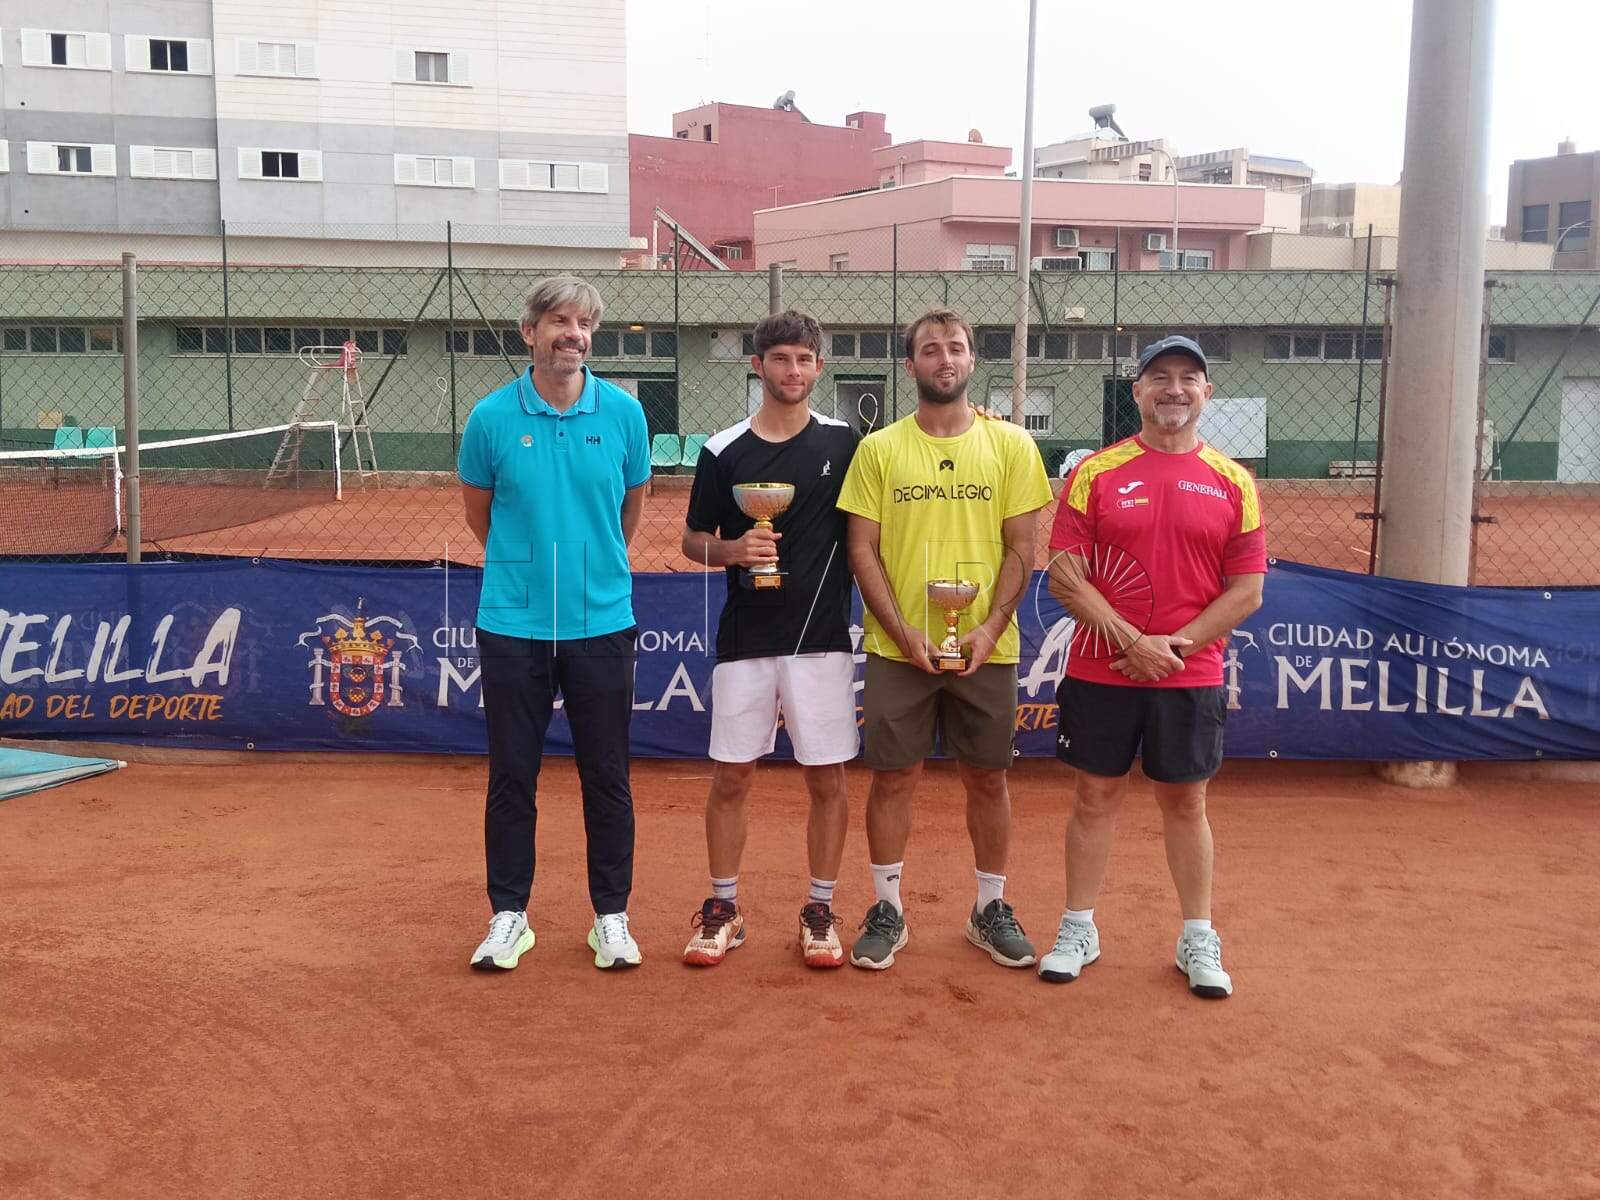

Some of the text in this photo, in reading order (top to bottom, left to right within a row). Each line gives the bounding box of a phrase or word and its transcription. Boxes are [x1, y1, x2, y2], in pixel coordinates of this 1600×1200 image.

[585, 435, 601, 445] HH
[893, 483, 993, 504] DECIMA LEGIO
[1177, 479, 1228, 500] GENERALI
[1268, 622, 1551, 668] CIUDAD AUTÓNOMA
[457, 656, 474, 668] DE
[1295, 655, 1313, 668] DE
[1273, 655, 1550, 720] MELILLA
[46, 694, 96, 720] DEL
[109, 693, 225, 721] DEPORTE
